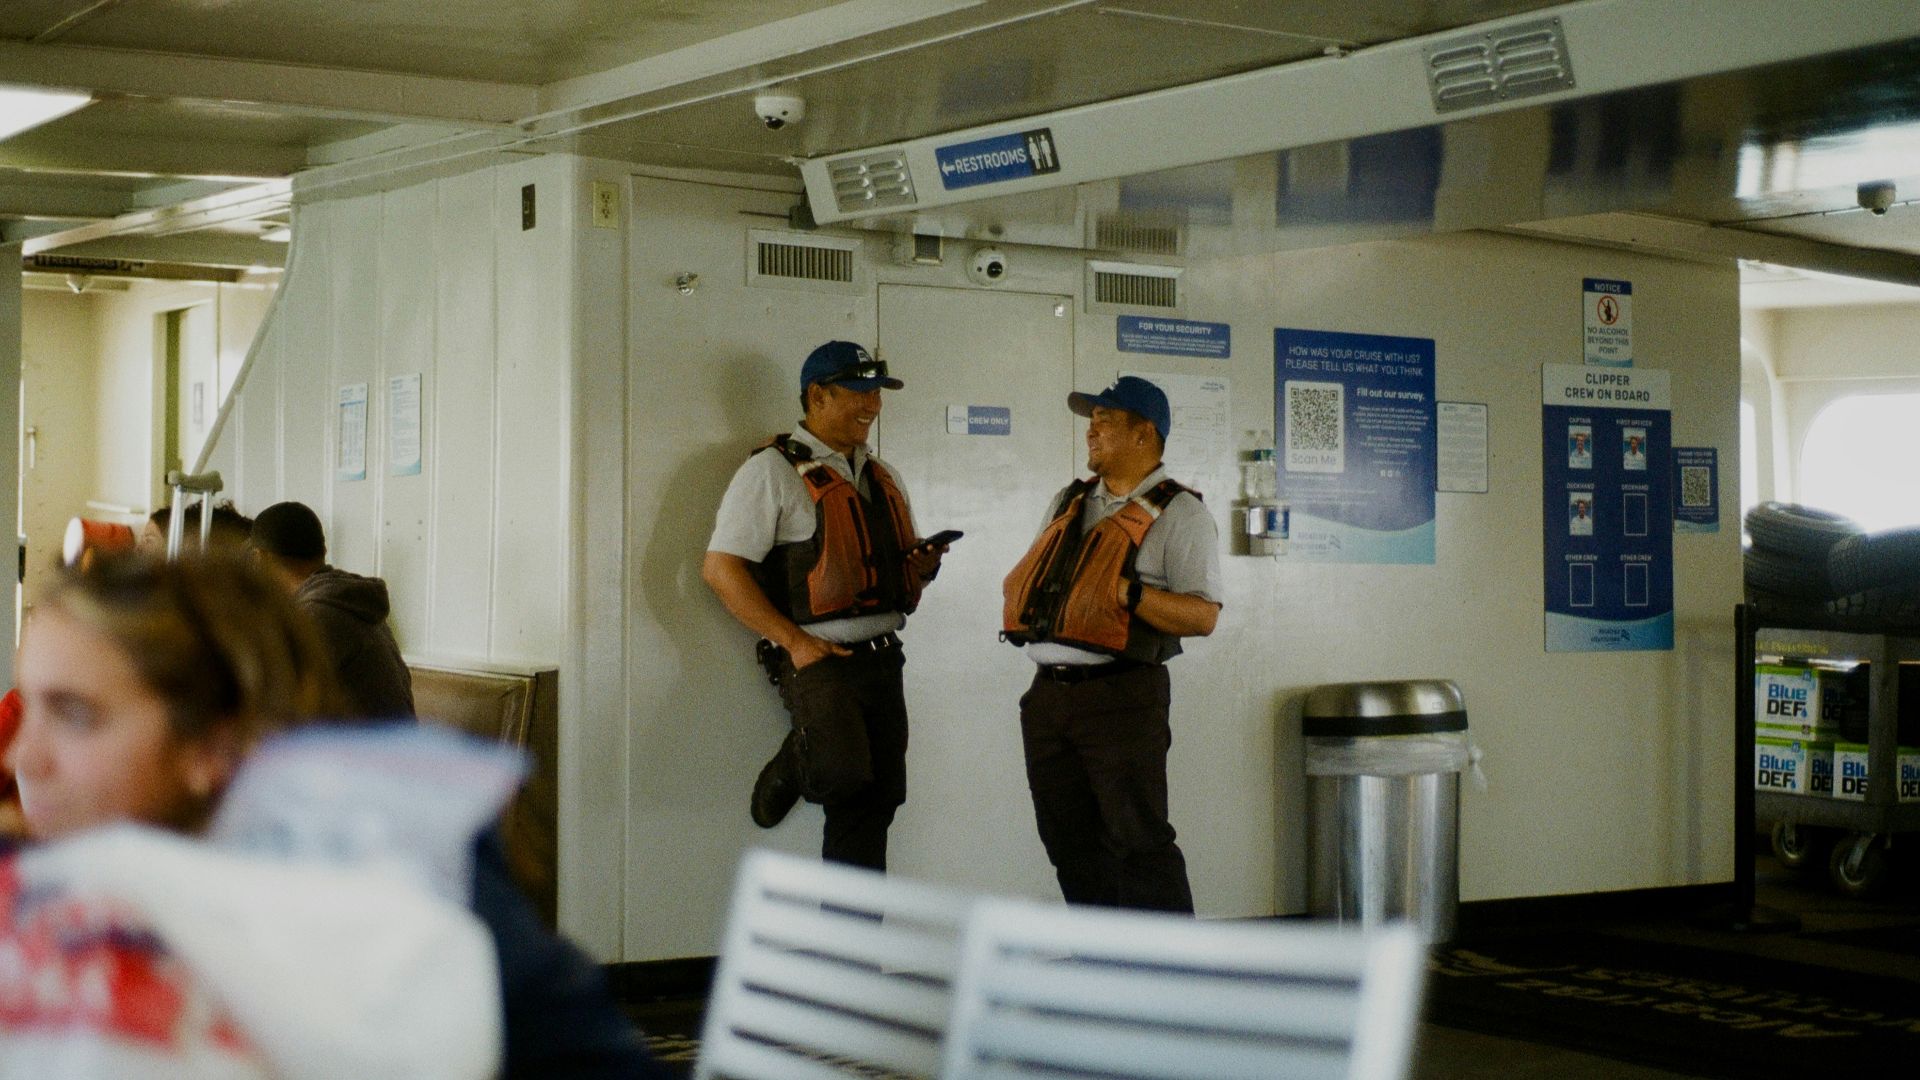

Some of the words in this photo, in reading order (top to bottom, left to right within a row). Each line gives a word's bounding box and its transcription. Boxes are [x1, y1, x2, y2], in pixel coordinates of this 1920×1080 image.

[955, 148, 1027, 174] RESTROOMS
[1594, 283, 1621, 293] NOTICE
[1139, 322, 1153, 330] FOR
[1155, 323, 1174, 332] YOUR
[1176, 326, 1211, 335] SECURITY
[1599, 327, 1628, 336] ALCOHOL
[1615, 338, 1629, 346] THIS
[1289, 346, 1308, 356] HOW
[1311, 348, 1328, 357] WAS
[1330, 349, 1352, 359] YOUR
[1354, 351, 1382, 361] CRUISE
[1384, 353, 1403, 362] WITH
[1405, 354, 1421, 364] US?
[1599, 346, 1618, 354] POINT
[1285, 359, 1318, 370] PLEASE
[1321, 361, 1340, 371] TELL
[1342, 362, 1354, 372] US
[1356, 363, 1378, 373] WHAT
[1381, 365, 1398, 375] YOU
[1400, 366, 1424, 377] THINK
[1585, 373, 1630, 386] CLIPPER
[1357, 387, 1368, 397] Fill
[1369, 389, 1382, 398] out
[1384, 391, 1396, 399] our
[1397, 392, 1425, 402] survey.
[1565, 387, 1594, 399] CREW
[1597, 389, 1611, 399] ON
[1615, 390, 1650, 402] BOARD
[969, 417, 989, 425] CREW
[990, 417, 1009, 425] ONLY
[1291, 453, 1318, 465] Scan
[1321, 454, 1336, 465] Me
[1768, 683, 1807, 700] Blue
[1767, 699, 1806, 717] DEF
[1759, 754, 1796, 771] Blue
[1812, 759, 1834, 775] Blu
[1758, 770, 1795, 788] DEF
[1902, 765, 1920, 780] Blu
[1811, 775, 1834, 792] DE
[1842, 777, 1868, 795] DE
[1902, 781, 1920, 797] DE
